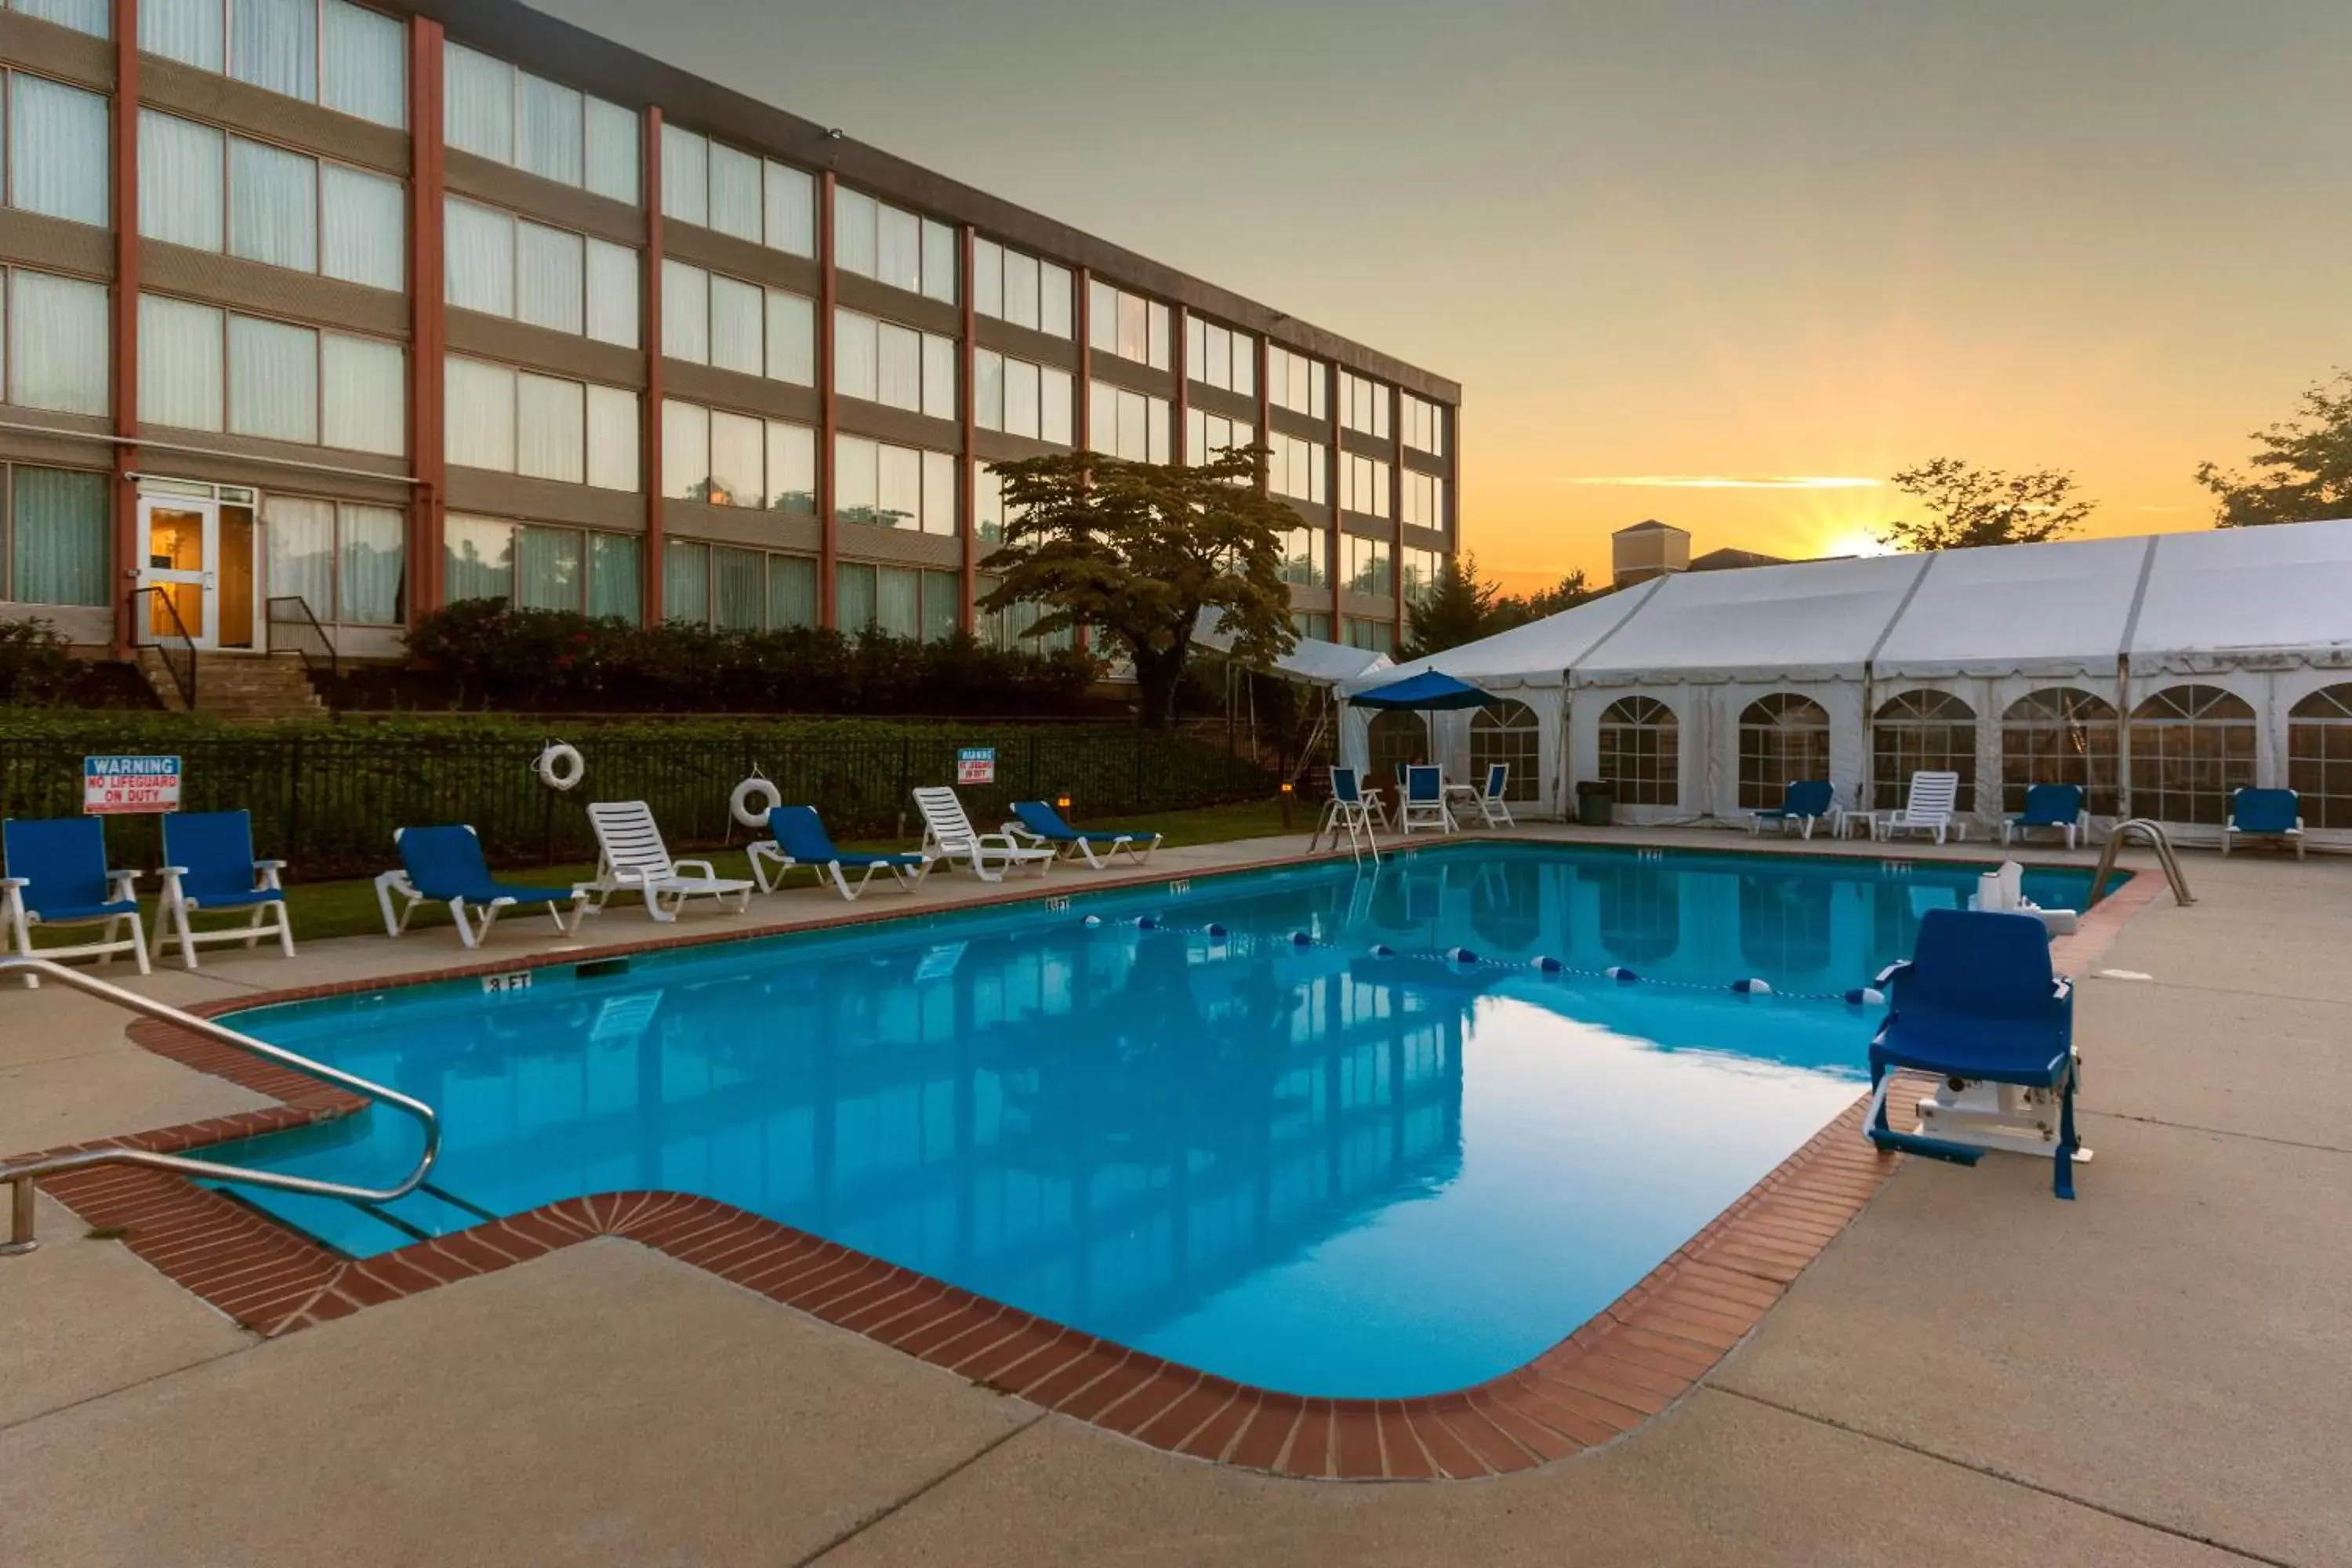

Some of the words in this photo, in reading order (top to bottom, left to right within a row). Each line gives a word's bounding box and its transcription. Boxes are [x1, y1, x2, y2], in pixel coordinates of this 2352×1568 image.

[94, 758, 173, 774] WARNING
[89, 775, 103, 788] NO
[111, 775, 176, 787] LIFEGUARD
[105, 789, 122, 801] ON
[128, 789, 159, 801] DUTY
[508, 974, 528, 990] FT
